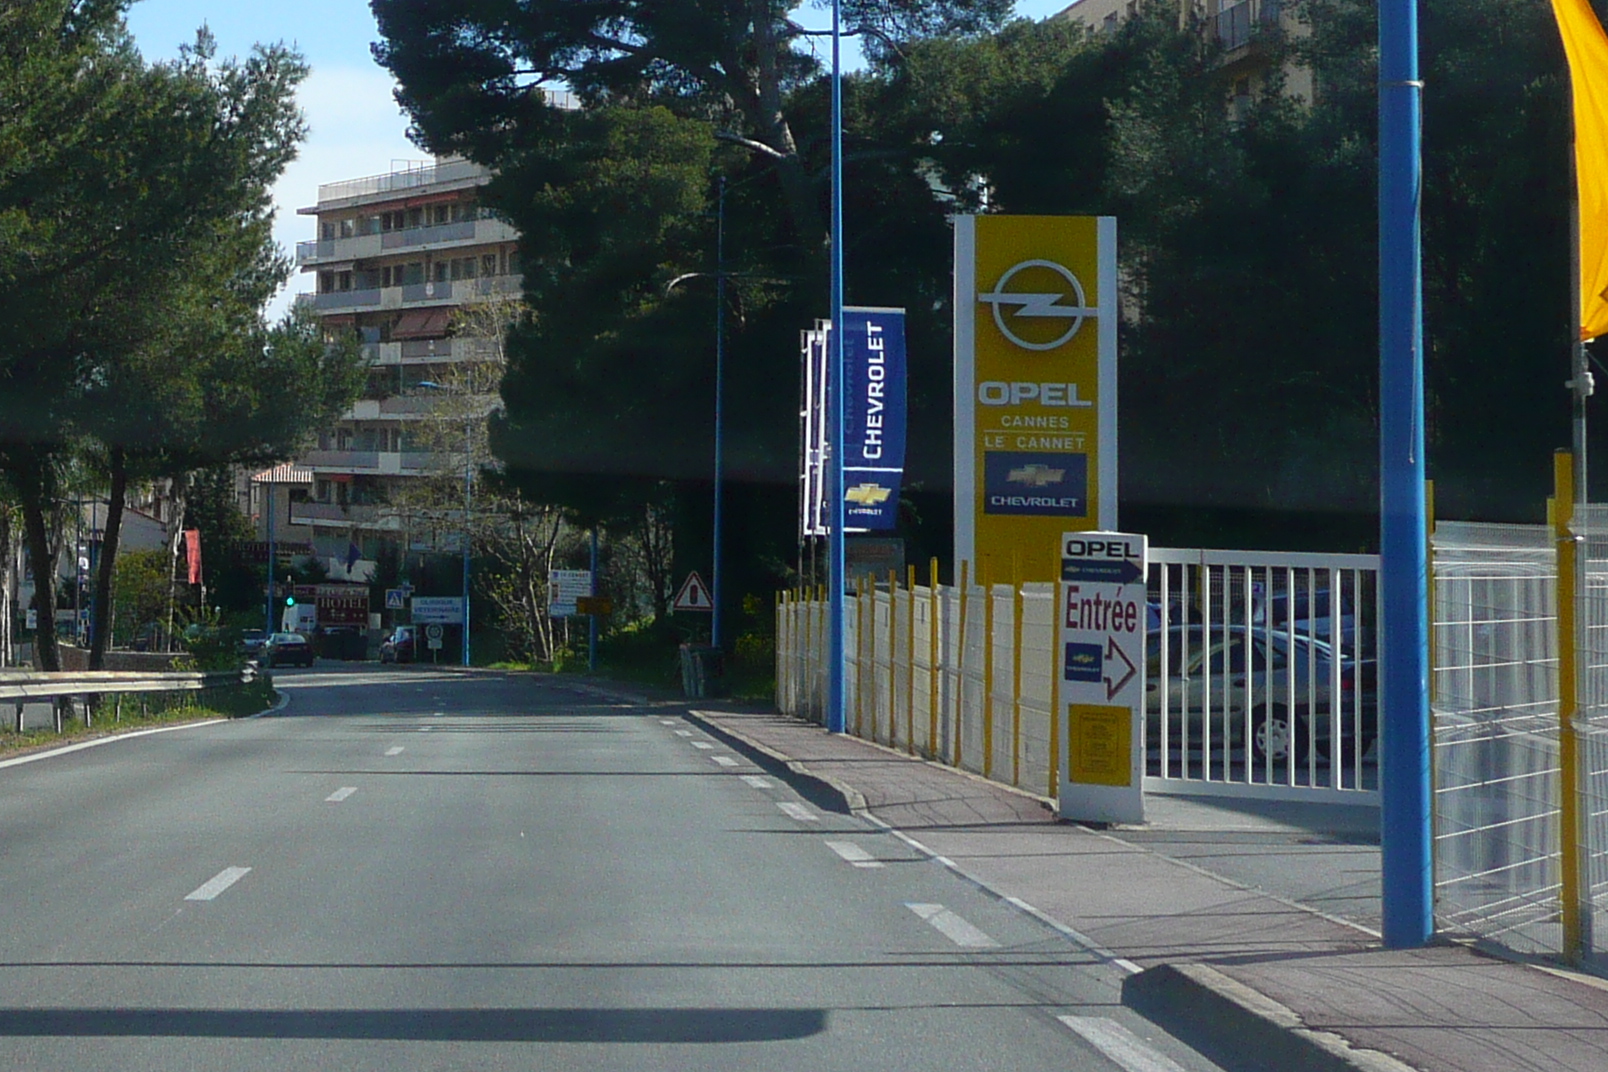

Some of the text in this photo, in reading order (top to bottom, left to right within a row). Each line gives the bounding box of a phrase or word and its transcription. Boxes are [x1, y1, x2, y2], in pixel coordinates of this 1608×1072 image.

[862, 321, 885, 459] CHEVROLET
[978, 381, 1092, 406] OPEL
[1001, 415, 1069, 428] CANNES
[984, 435, 1085, 450] LE CANNET
[991, 495, 1078, 508] CHEVROLET
[1066, 540, 1139, 558] OPEL
[320, 597, 366, 609] HOTEL
[1065, 585, 1138, 633] Entrée
